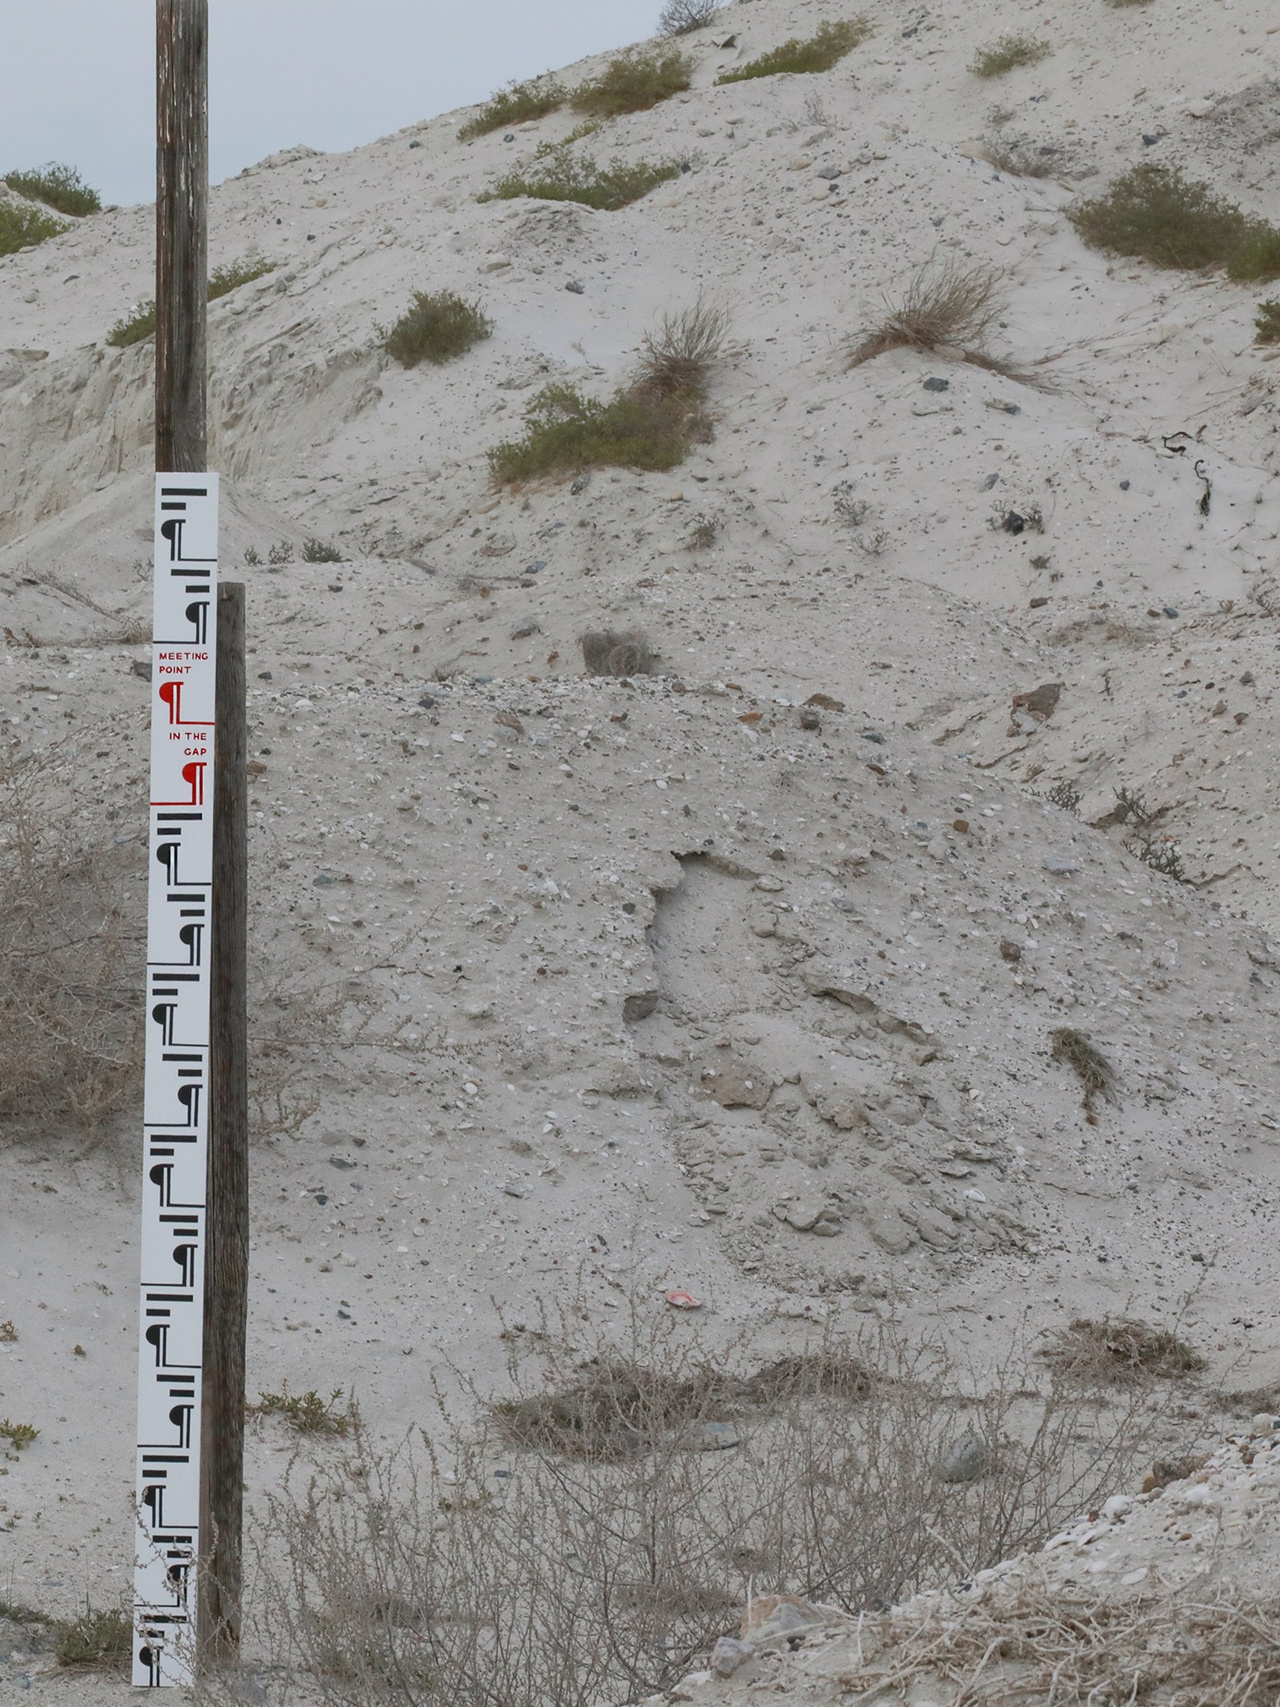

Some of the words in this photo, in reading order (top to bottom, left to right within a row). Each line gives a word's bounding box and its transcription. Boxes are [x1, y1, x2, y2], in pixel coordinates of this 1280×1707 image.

[159, 652, 208, 660] MEETING
[159, 666, 191, 674] POINT
[169, 732, 180, 740] IN
[185, 732, 207, 740] THE
[184, 748, 207, 756] GAP
